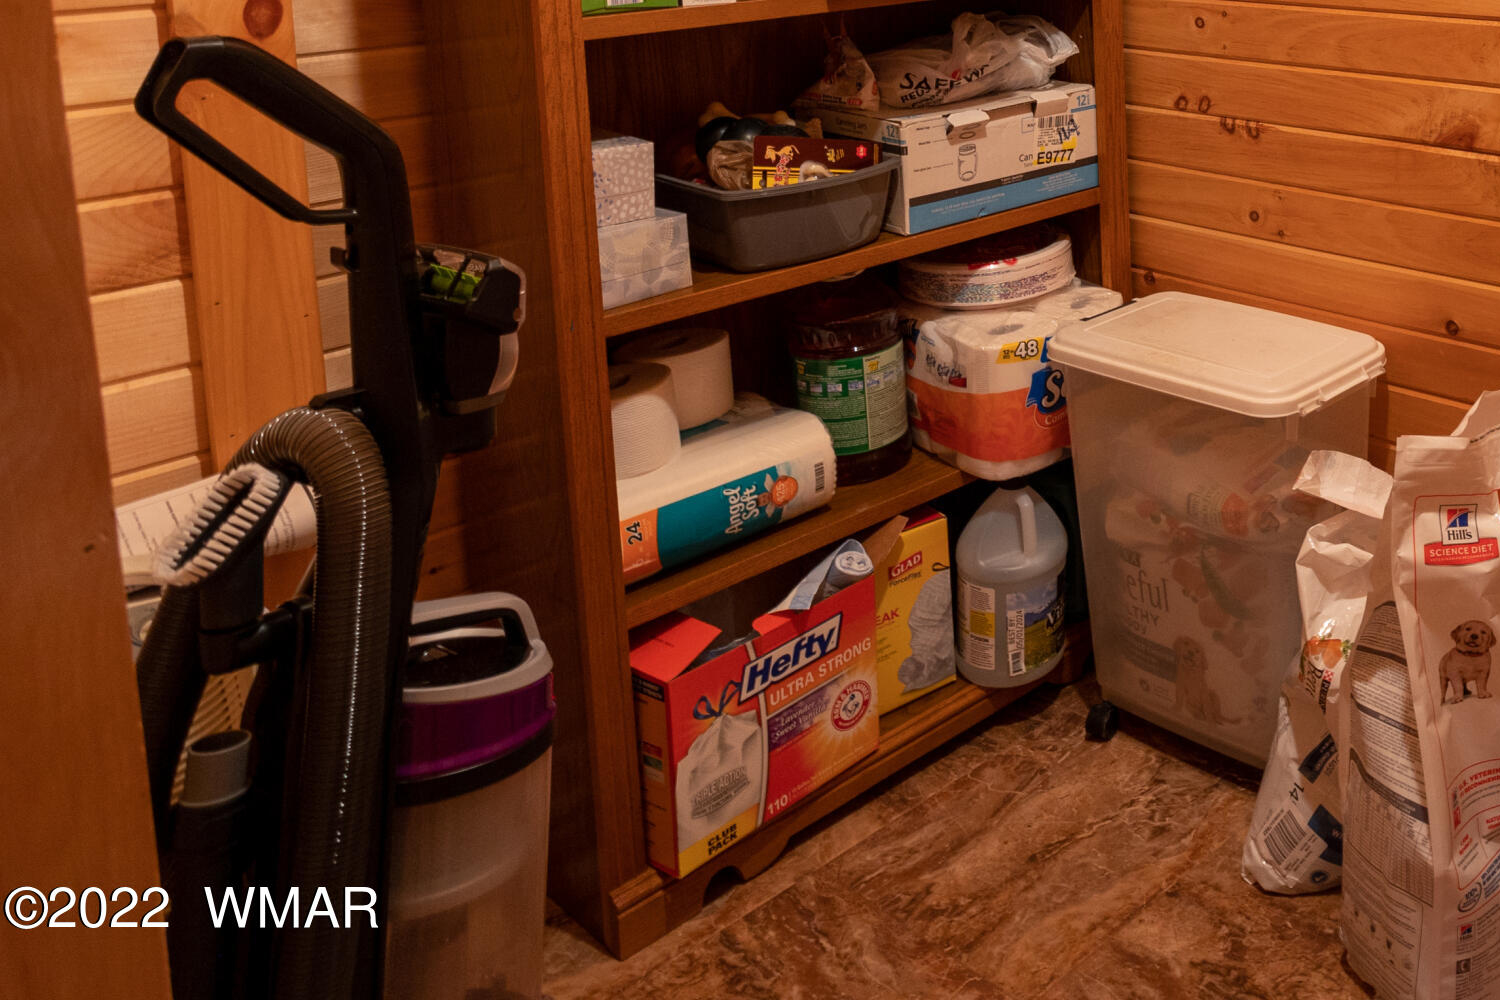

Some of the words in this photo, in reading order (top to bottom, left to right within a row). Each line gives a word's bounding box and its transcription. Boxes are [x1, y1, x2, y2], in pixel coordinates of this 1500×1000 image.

[1036, 148, 1074, 165] E9777
[1014, 339, 1038, 358] 48
[723, 486, 743, 535] Angel
[741, 484, 759, 521] Soft
[626, 520, 643, 545] 24
[1447, 529, 1473, 541] Hill's
[1429, 546, 1469, 558] SCIENCE
[1471, 543, 1494, 554] DIET
[890, 554, 922, 578] GLAD
[1126, 569, 1169, 613] eful
[746, 627, 836, 693] Hefty
[769, 671, 815, 706] ULTRA
[818, 637, 872, 677] STRONG
[767, 794, 789, 815] 110
[707, 823, 737, 847] CLUB
[708, 832, 738, 856] PACK
